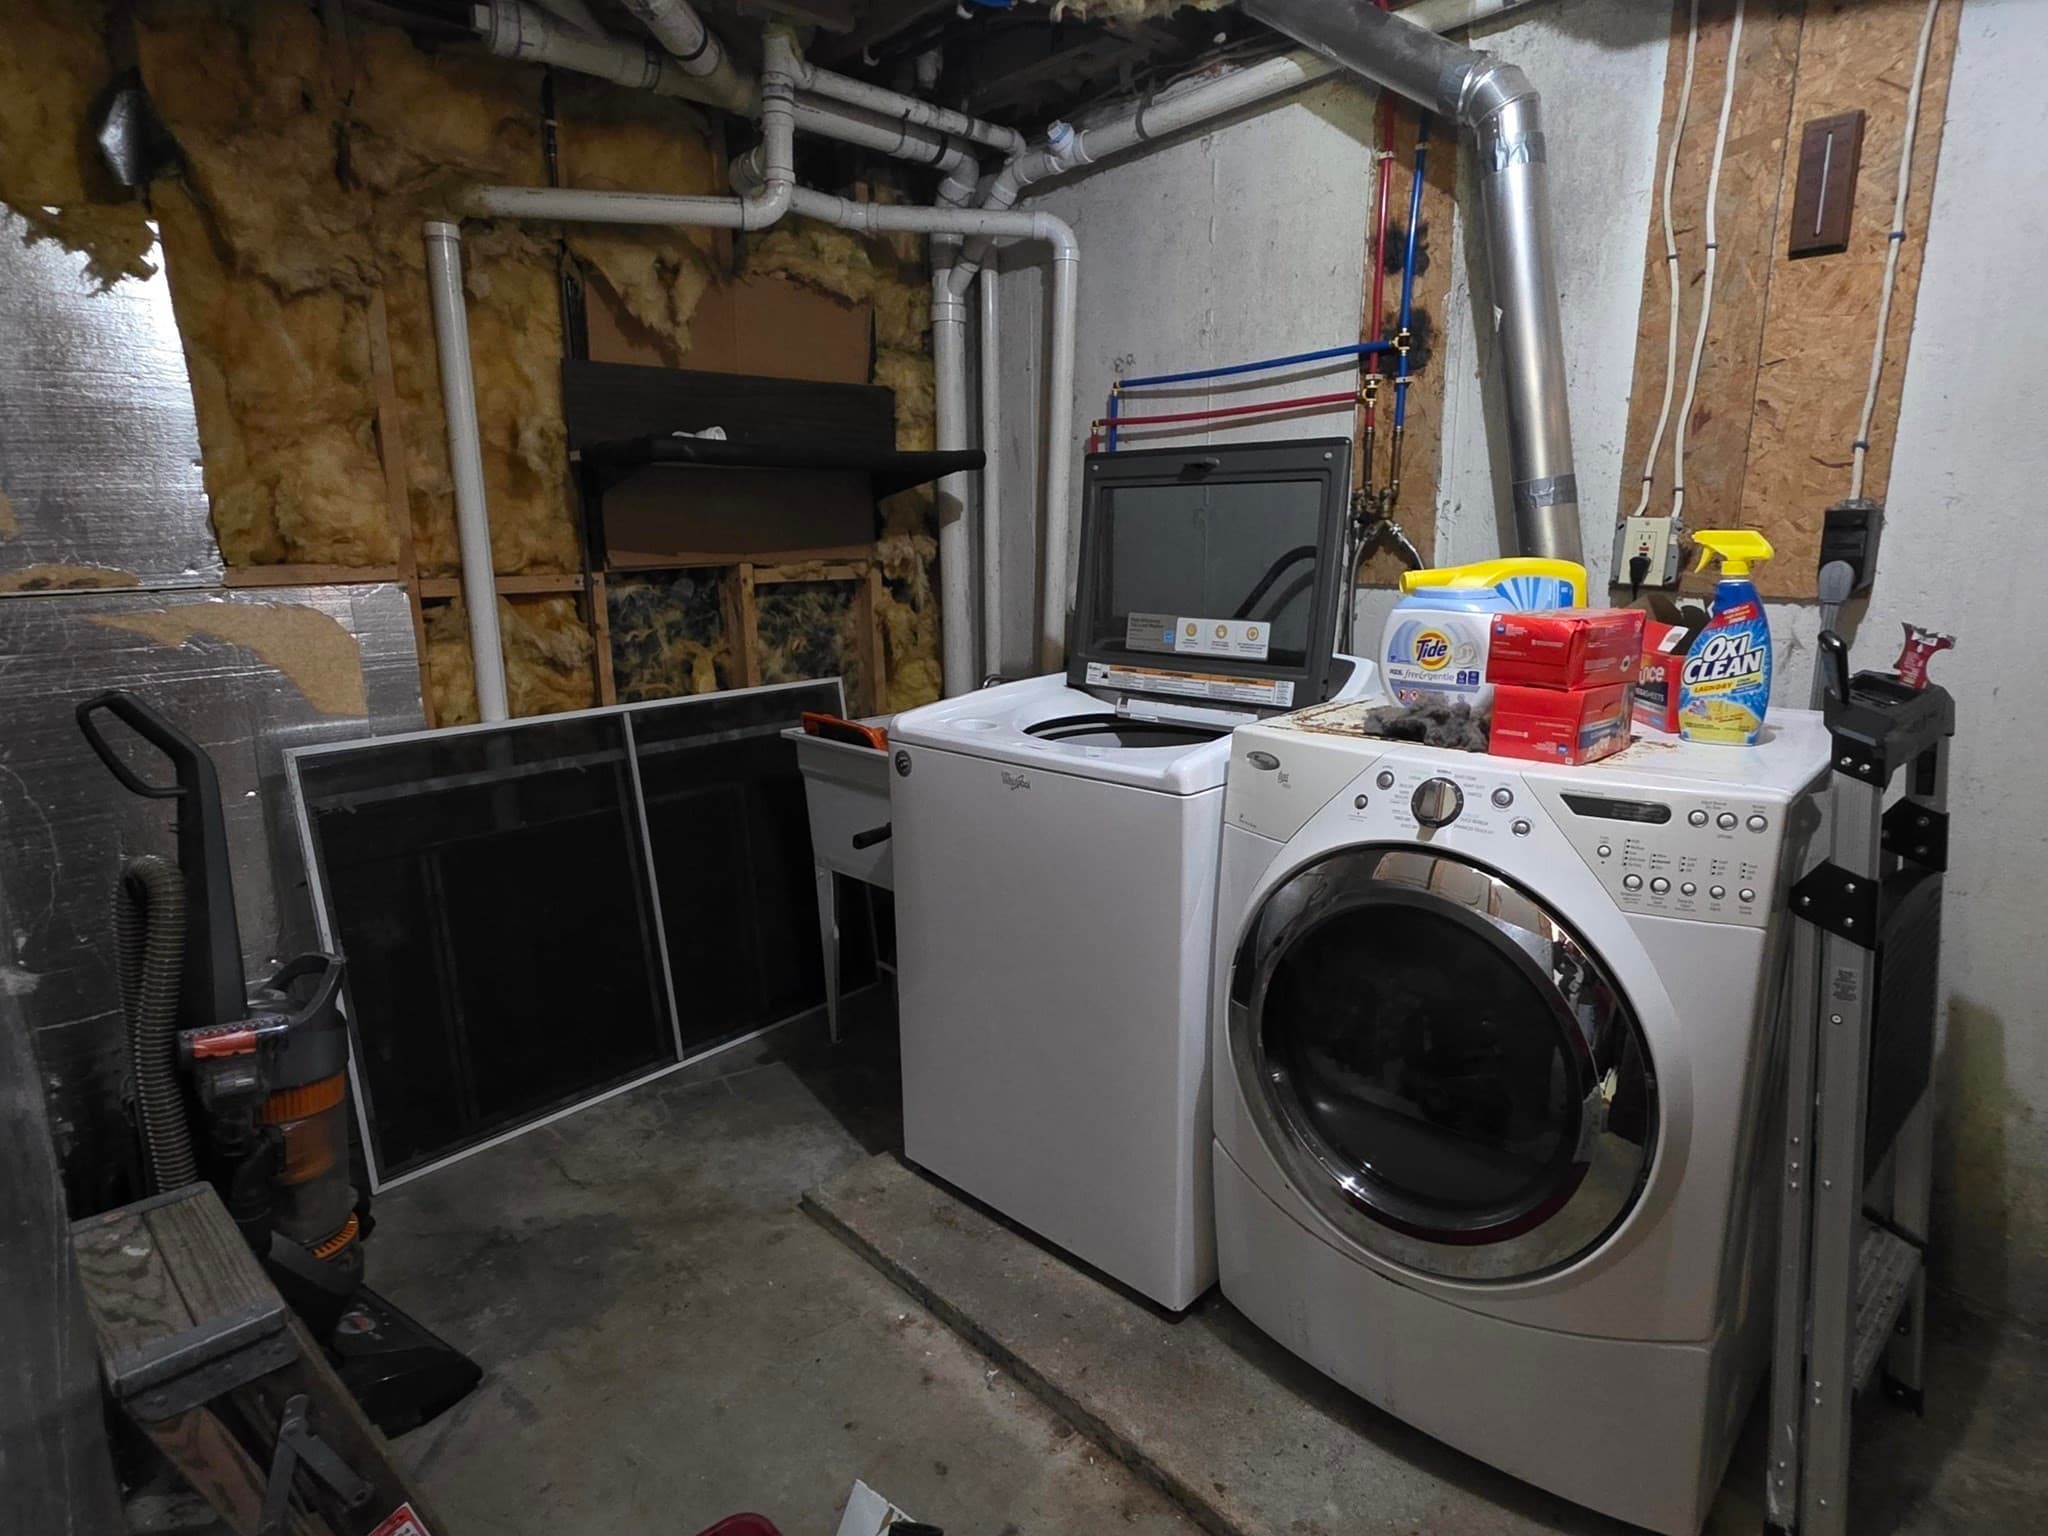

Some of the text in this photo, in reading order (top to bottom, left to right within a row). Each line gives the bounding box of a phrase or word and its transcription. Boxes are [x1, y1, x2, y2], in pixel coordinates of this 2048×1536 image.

[1416, 638, 1448, 661] Tide
[1703, 634, 1750, 662] OXI
[1639, 665, 1665, 685] unce
[1684, 649, 1764, 684] CLEAN
